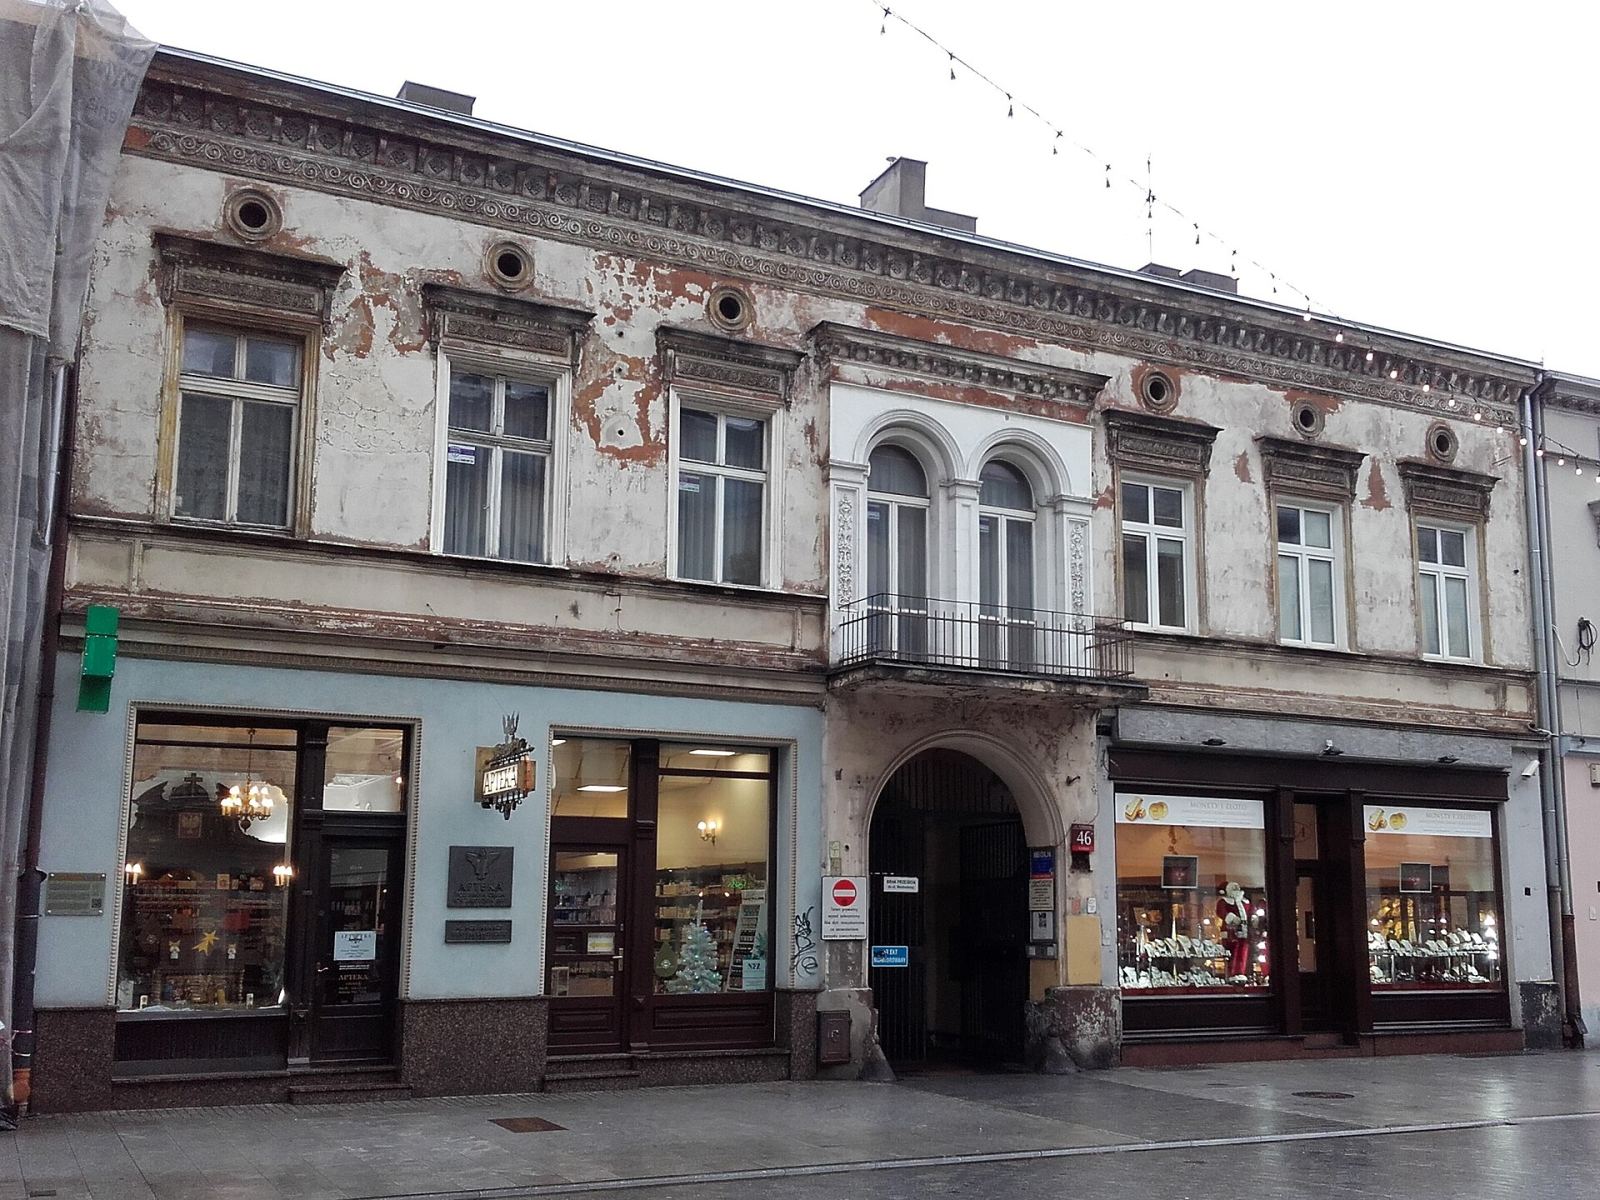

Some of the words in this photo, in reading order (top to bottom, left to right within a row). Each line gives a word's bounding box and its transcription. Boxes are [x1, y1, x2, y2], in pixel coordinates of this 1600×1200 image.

[484, 766, 517, 793] APTEKA
[1076, 830, 1092, 846] 46
[457, 882, 504, 892] APTEKA
